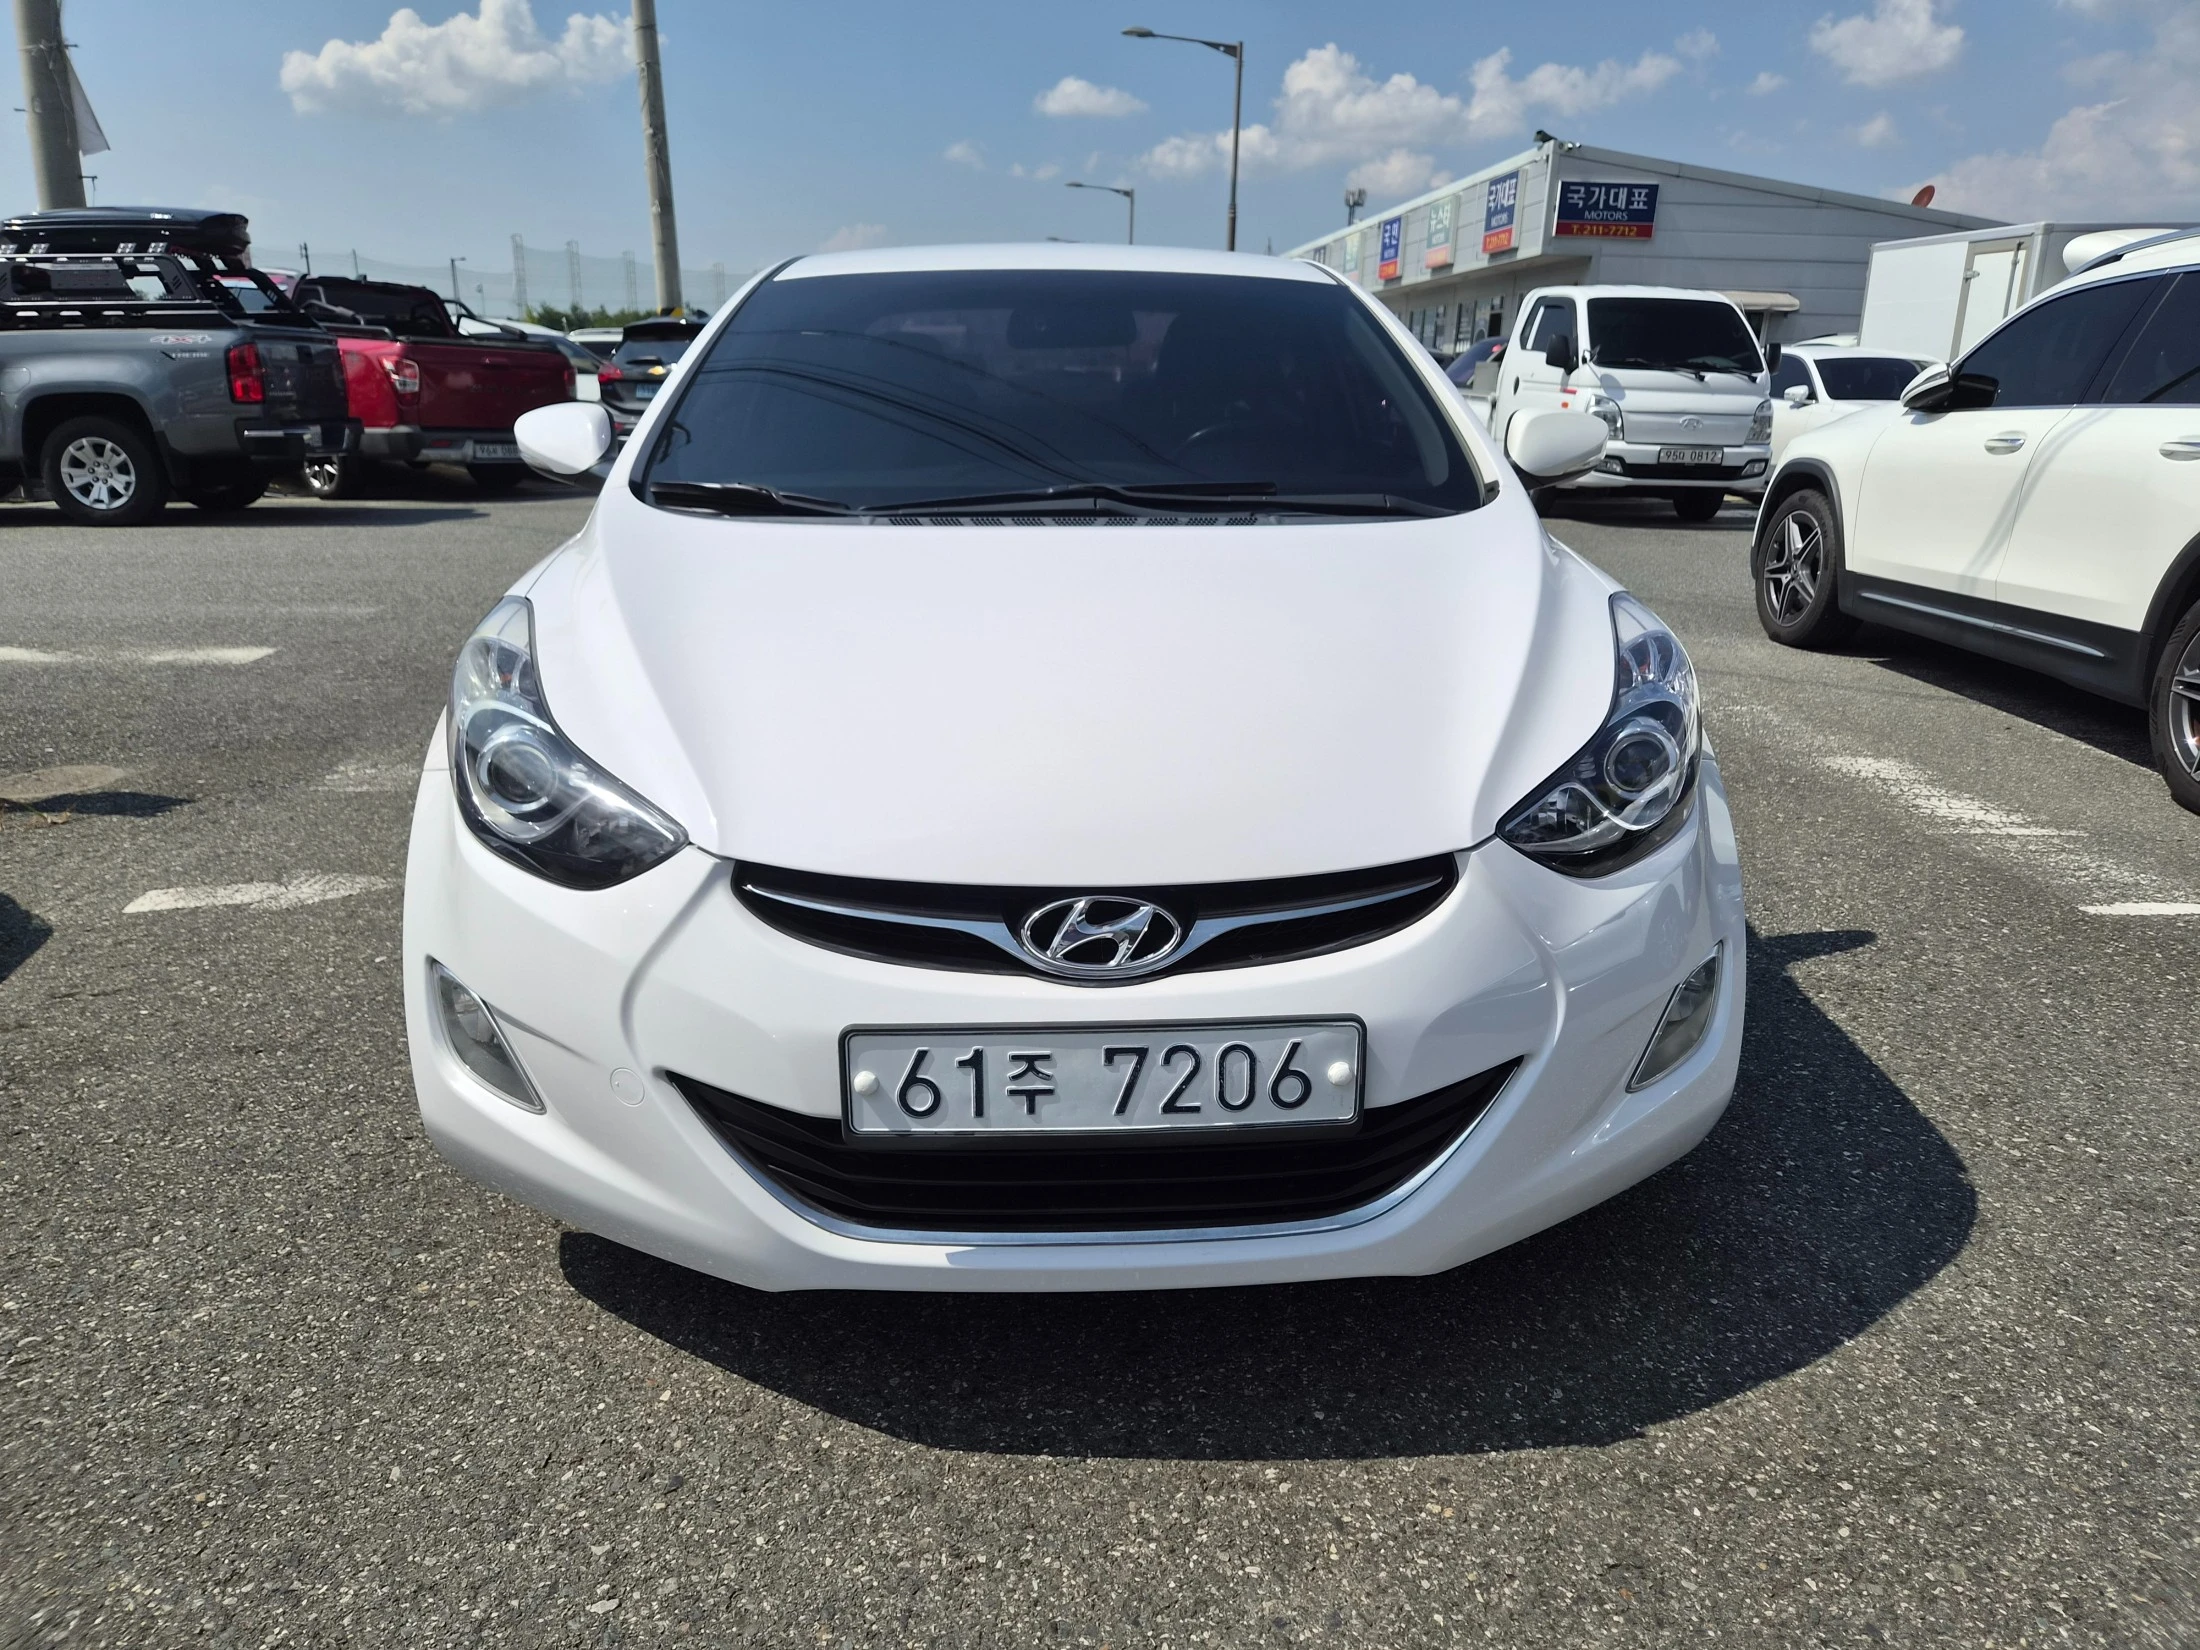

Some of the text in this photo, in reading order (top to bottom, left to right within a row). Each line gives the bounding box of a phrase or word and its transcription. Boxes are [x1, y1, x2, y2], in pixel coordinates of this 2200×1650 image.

[1567, 185, 1649, 210] 국가대표
[1584, 209, 1628, 221] MOTORS
[896, 1039, 1313, 1119] 61주 7206
